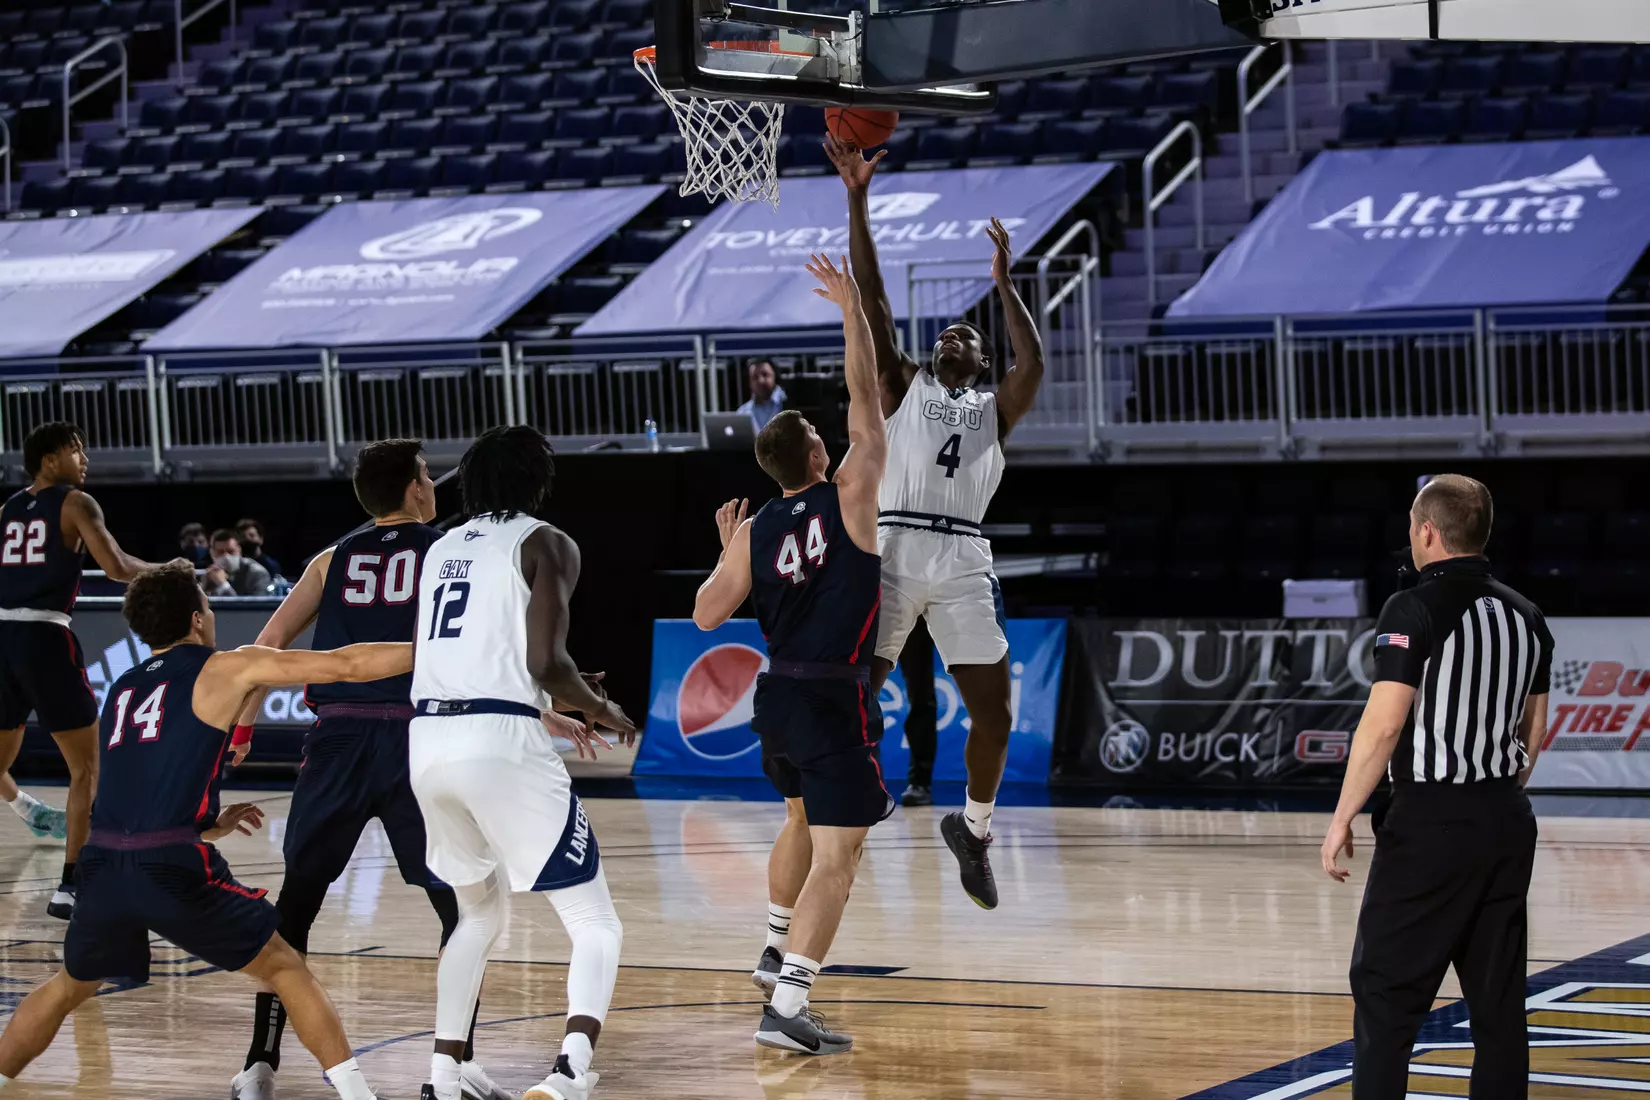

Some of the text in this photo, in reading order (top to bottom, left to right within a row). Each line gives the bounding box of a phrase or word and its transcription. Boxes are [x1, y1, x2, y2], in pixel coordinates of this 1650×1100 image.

[1307, 191, 1585, 230] Altura
[923, 399, 982, 431] CBU
[936, 433, 962, 478] 4
[2, 519, 48, 565] 22
[774, 514, 828, 587] 44
[342, 547, 419, 606] 50
[439, 559, 473, 579] GAK
[428, 581, 471, 641] 12
[108, 681, 170, 750] 14
[1540, 703, 1634, 751] TIRE
[1157, 732, 1260, 762] BUICK
